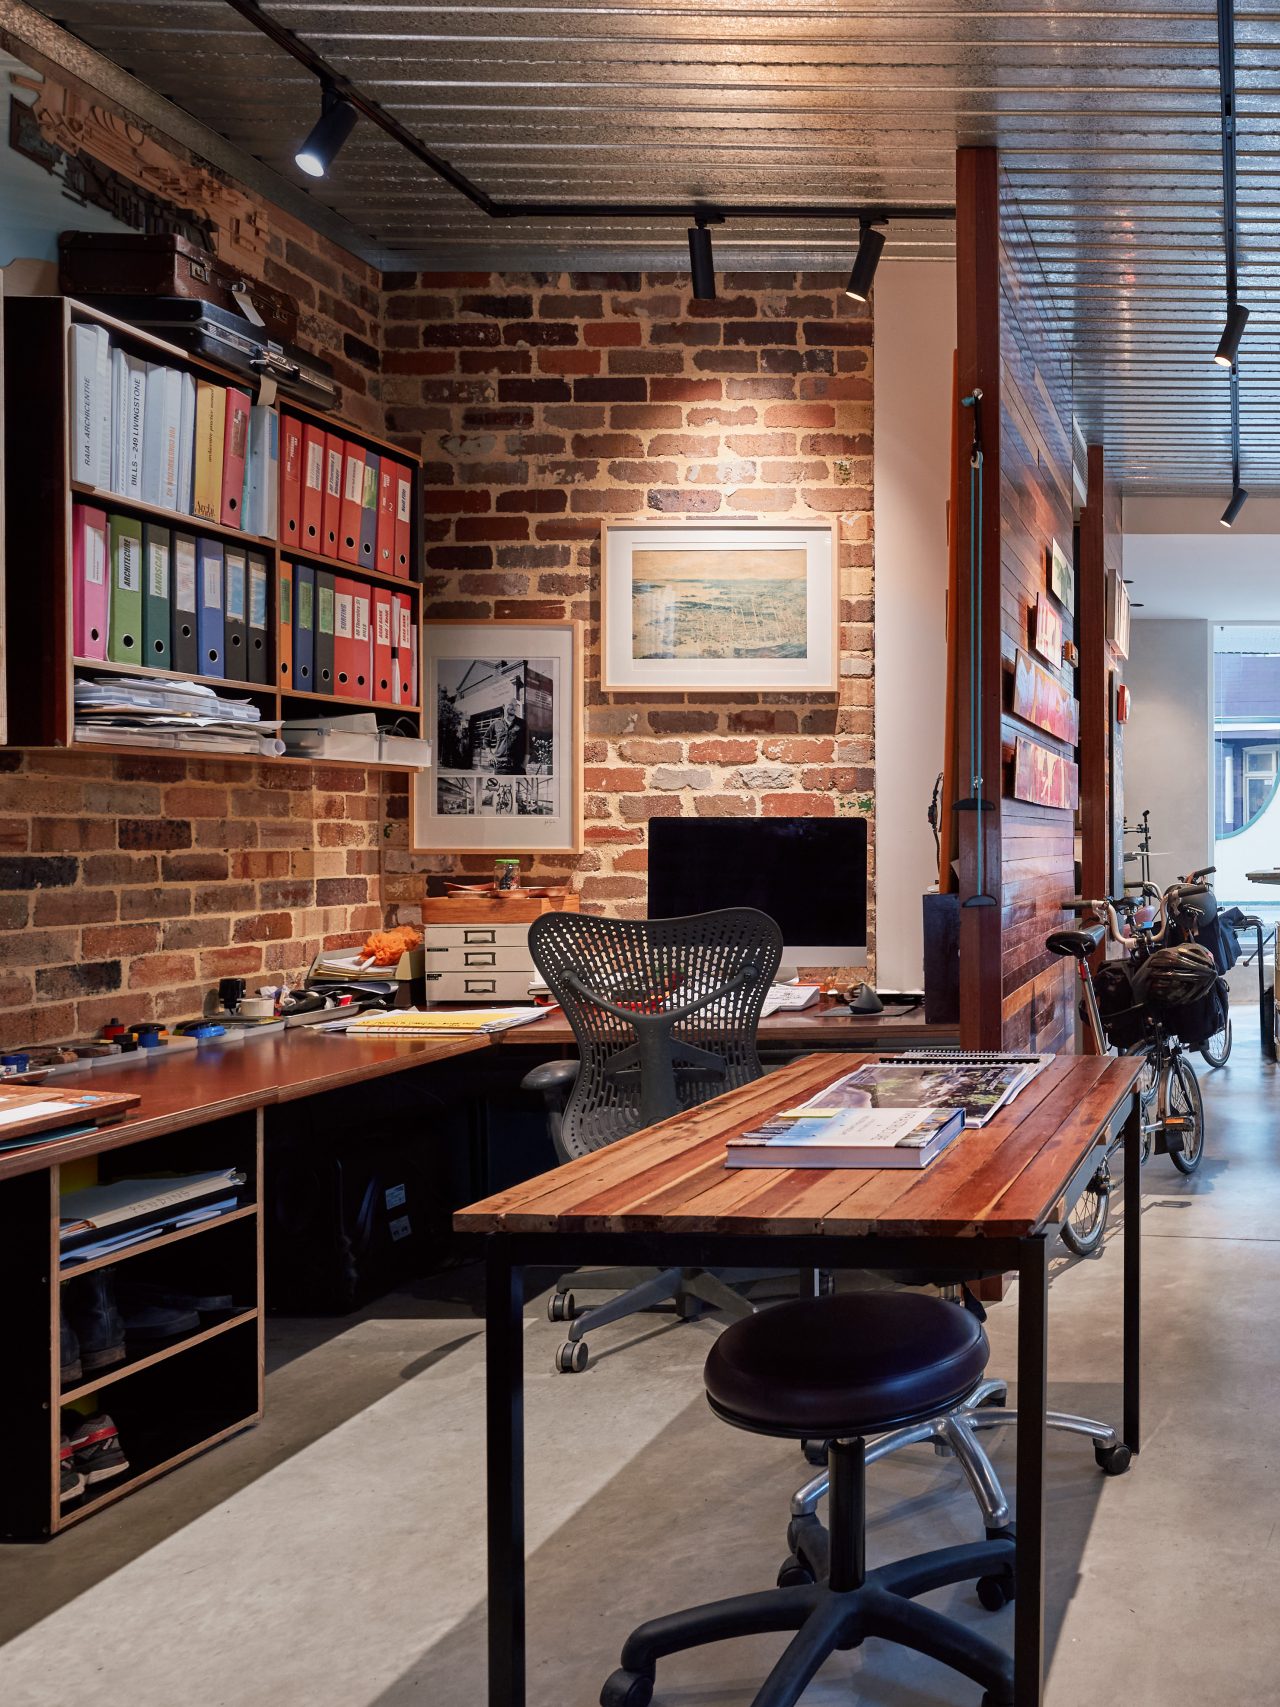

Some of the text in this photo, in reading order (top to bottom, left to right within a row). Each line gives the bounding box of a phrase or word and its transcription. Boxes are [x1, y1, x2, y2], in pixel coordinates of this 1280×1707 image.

[83, 376, 91, 439] ARCHICENTRE
[132, 377, 141, 437] LIVINGSTONE
[83, 445, 91, 467] RAIA
[132, 437, 140, 453] 249
[130, 461, 139, 487] BILLS
[123, 538, 131, 588] ARCHITECURE
[129, 1190, 191, 1213] PENDING
